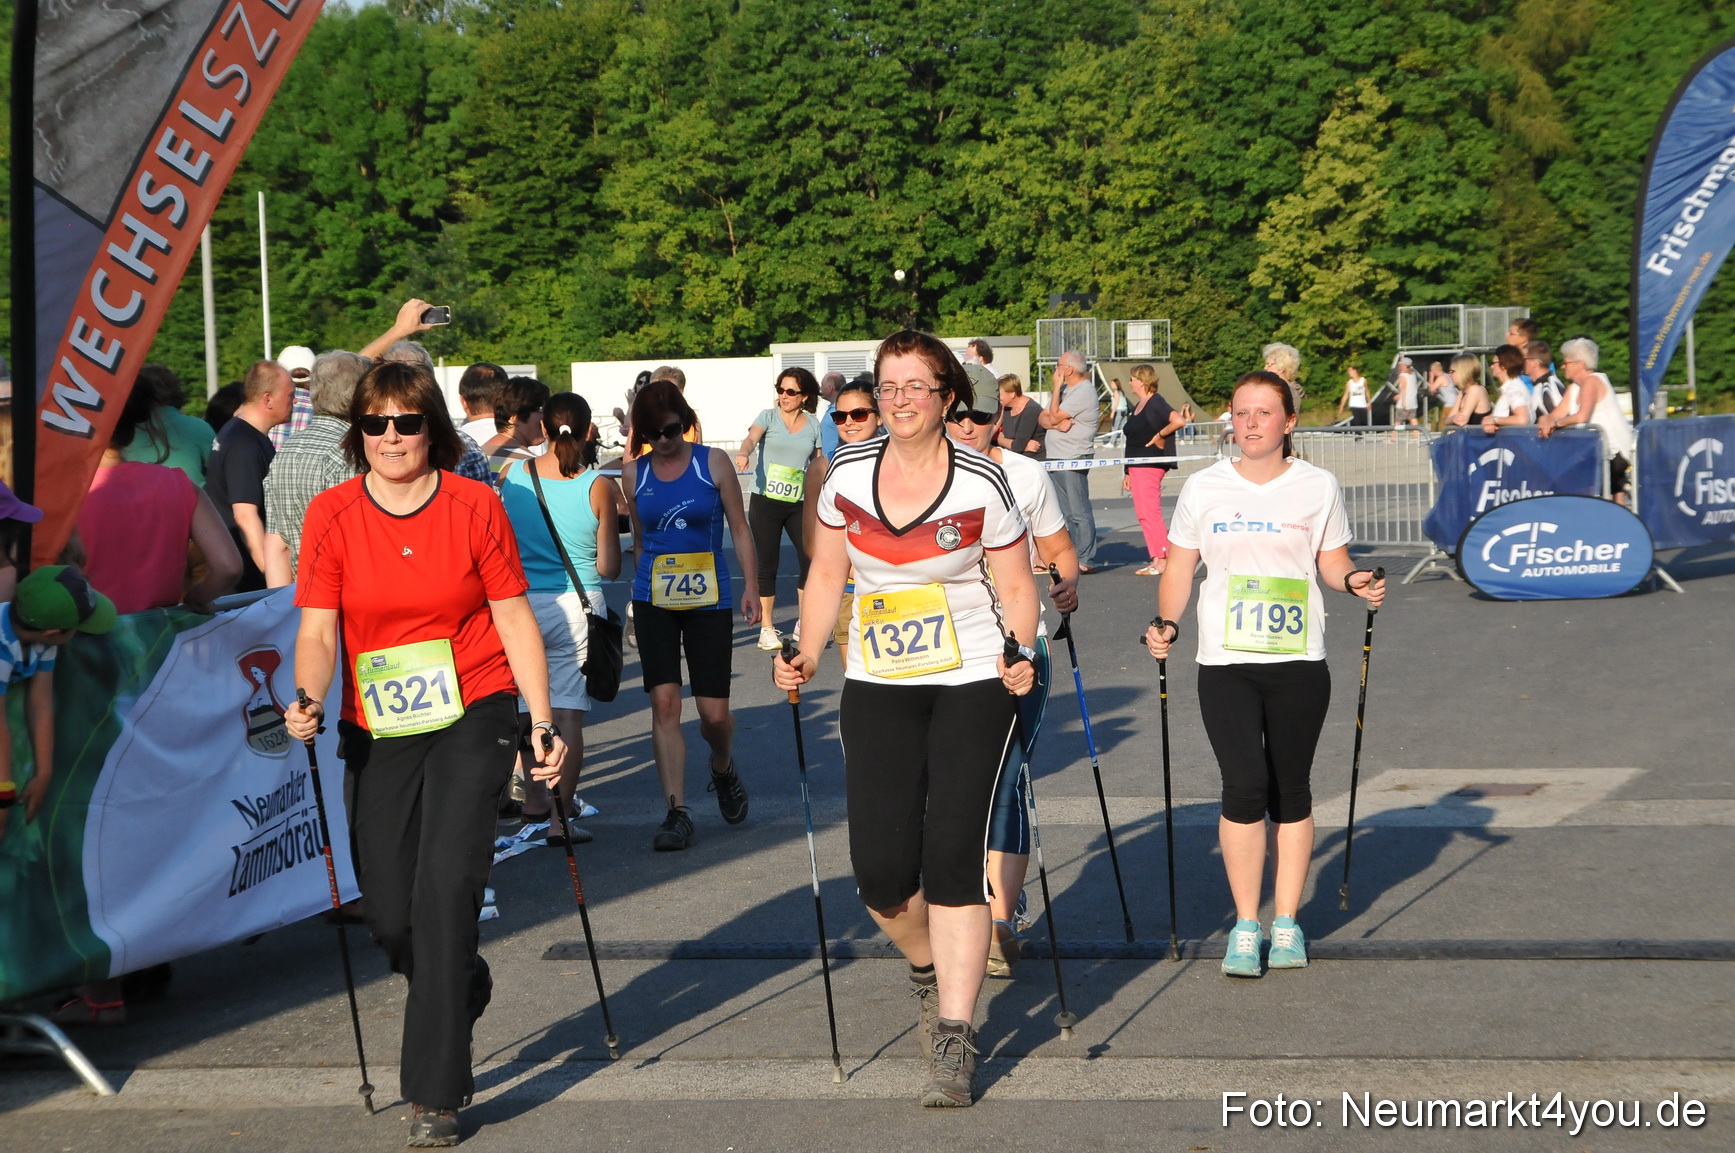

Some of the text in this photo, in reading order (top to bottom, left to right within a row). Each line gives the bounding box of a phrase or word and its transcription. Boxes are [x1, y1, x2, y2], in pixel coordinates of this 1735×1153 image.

[1644, 251, 1712, 371] www.frischmann-net.de
[766, 480, 800, 498] 5091
[656, 518, 665, 530] Team
[663, 504, 681, 518] Schick
[1281, 522, 1310, 533] energie
[1508, 540, 1630, 566] Fischer
[1521, 563, 1621, 578] AUTOMOBILE
[661, 573, 707, 597] 743
[1229, 601, 1304, 635] 1193
[863, 614, 945, 659] 1327
[367, 661, 401, 675] firmenlauf
[872, 666, 896, 675] Sparkasse
[896, 660, 939, 672] Neumarkt-Parsberg
[905, 654, 929, 663] Wittmann
[363, 670, 450, 717] 1321
[375, 724, 399, 733] Sparkasse
[399, 717, 443, 729] Neumarkt-Parsberg
[396, 711, 432, 723] Agnes Richter
[257, 729, 289, 752] 1628
[230, 770, 307, 831] Neumarkter
[228, 808, 325, 899] Lammsbräu
